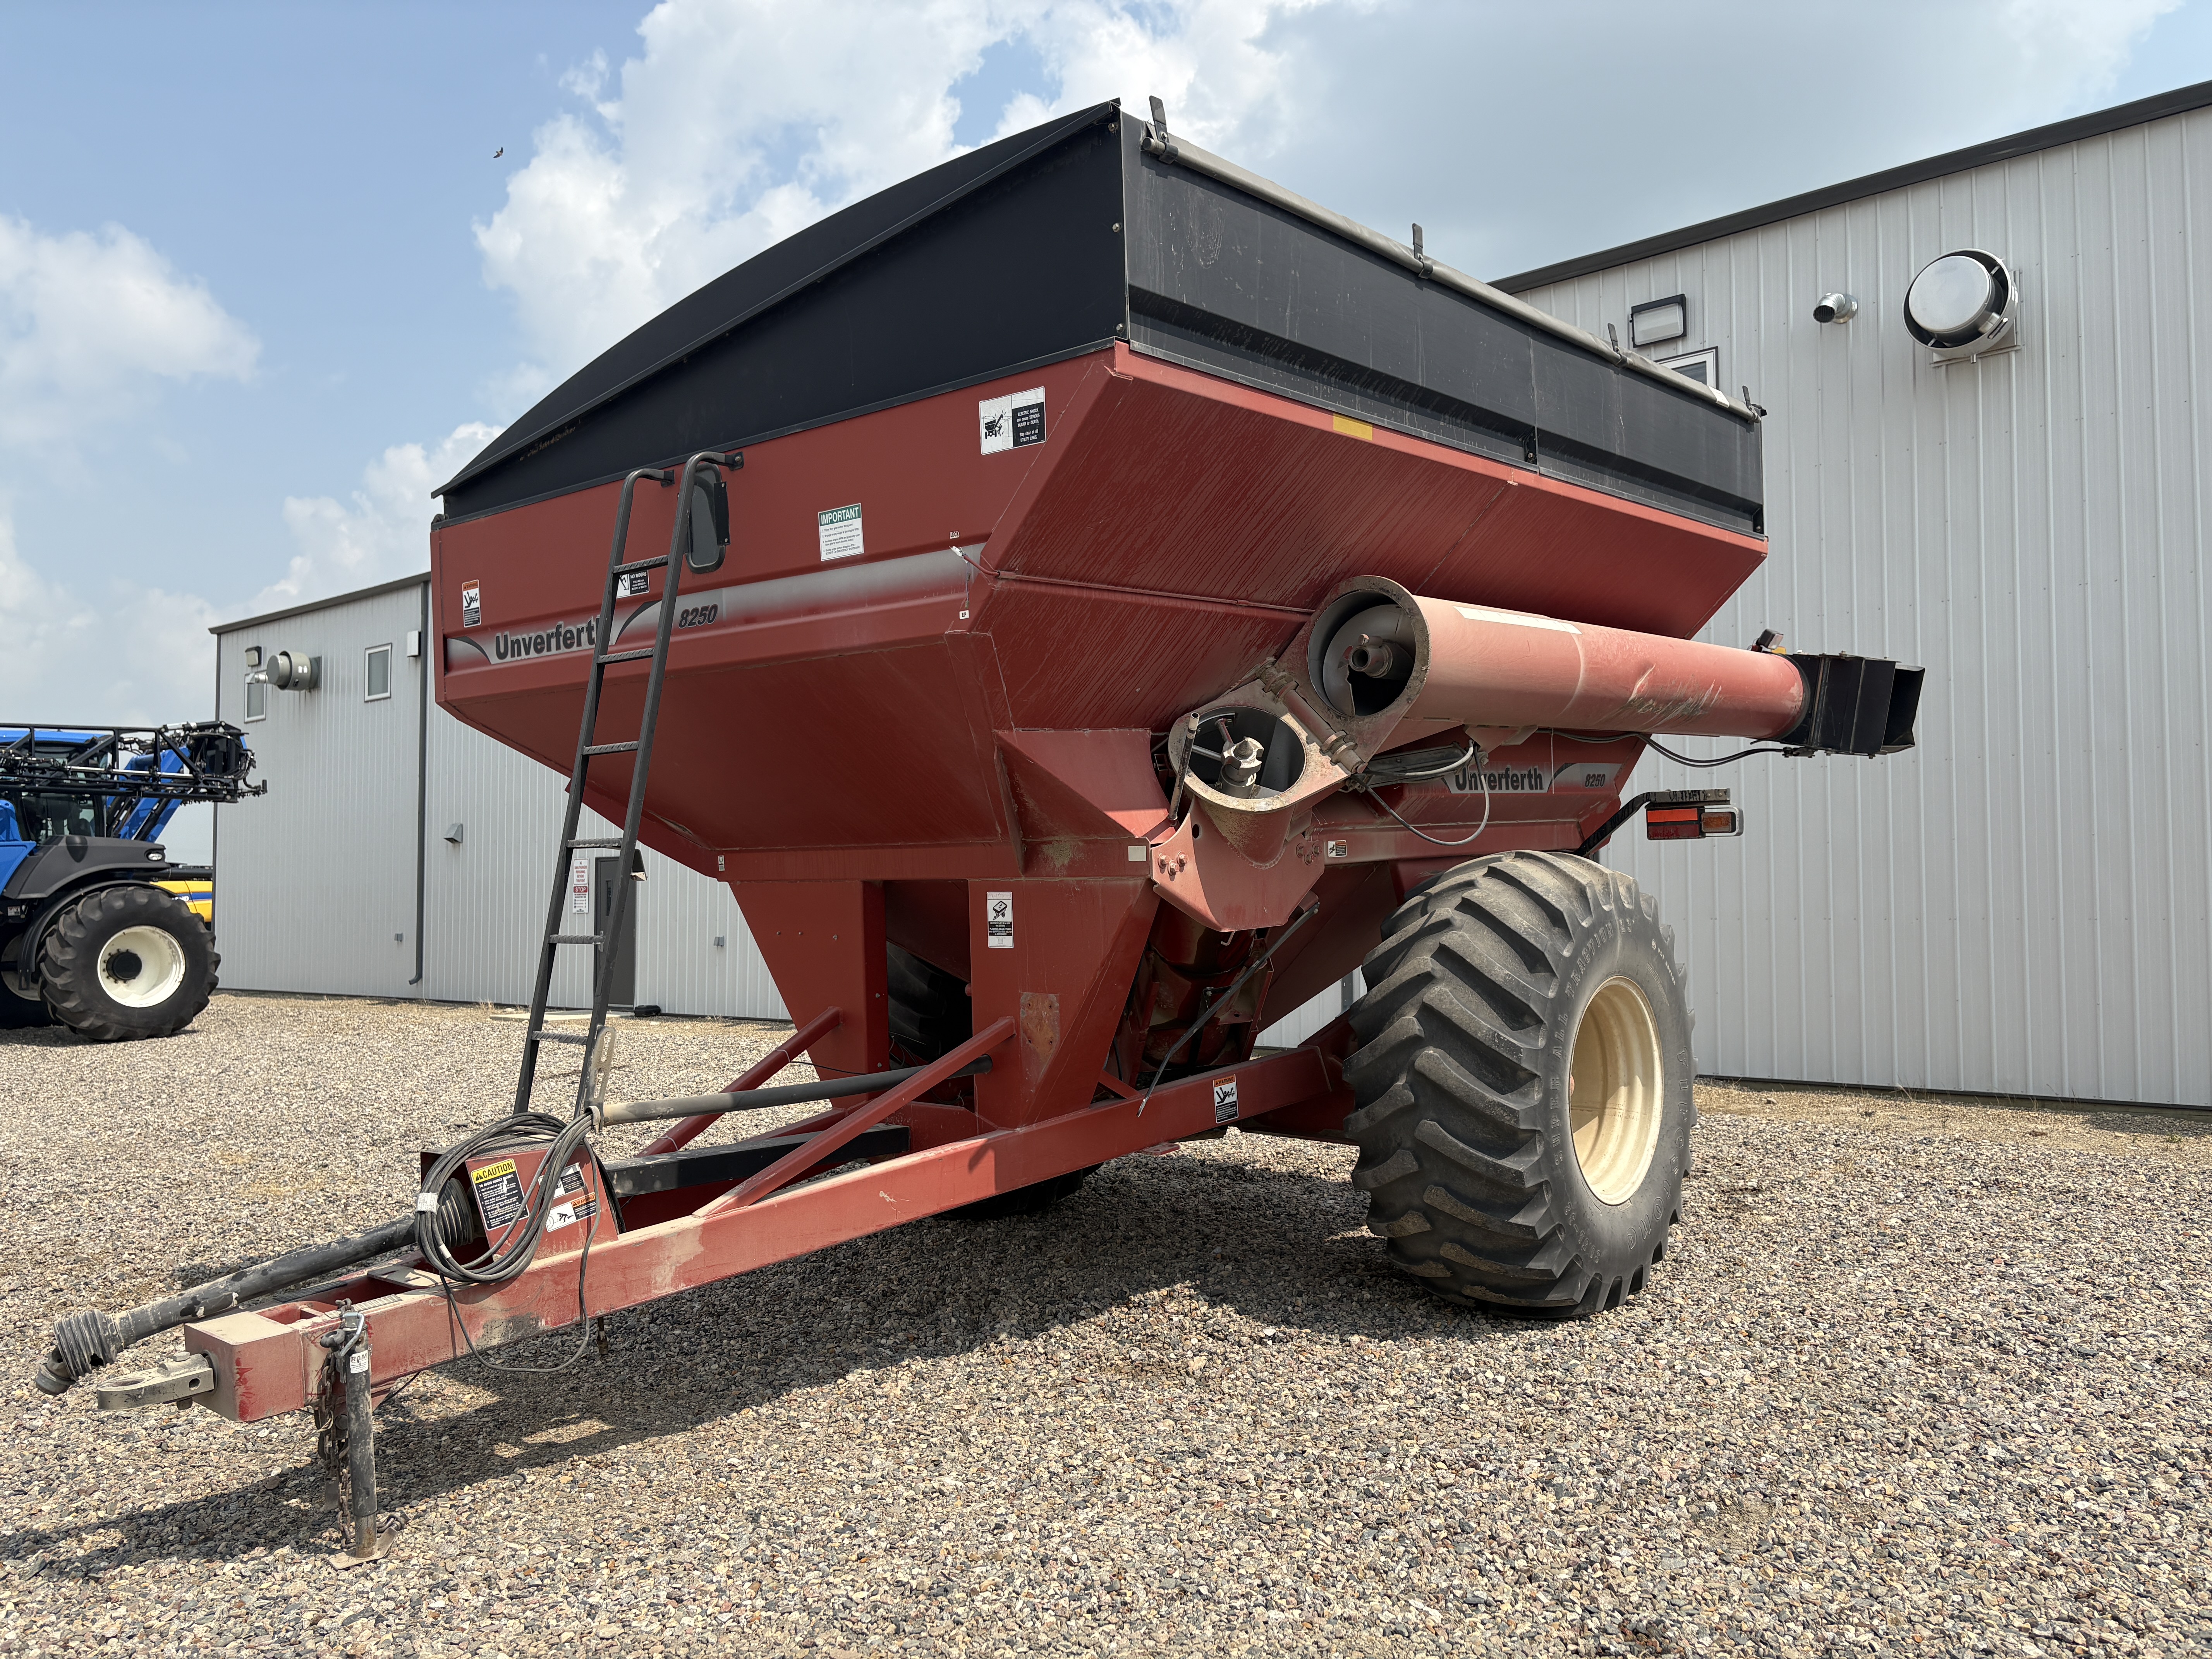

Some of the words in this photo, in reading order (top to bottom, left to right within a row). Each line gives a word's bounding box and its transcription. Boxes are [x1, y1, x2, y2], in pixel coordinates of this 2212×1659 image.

[821, 507, 859, 525] IMPORTANT
[679, 604, 718, 628] 8250
[1585, 773, 1606, 787] 8250
[1565, 921, 1614, 999] TRACTION
[483, 1162, 514, 1178] CAUTION
[576, 1195, 594, 1205] WARNING
[351, 1353, 367, 1362] RAM
